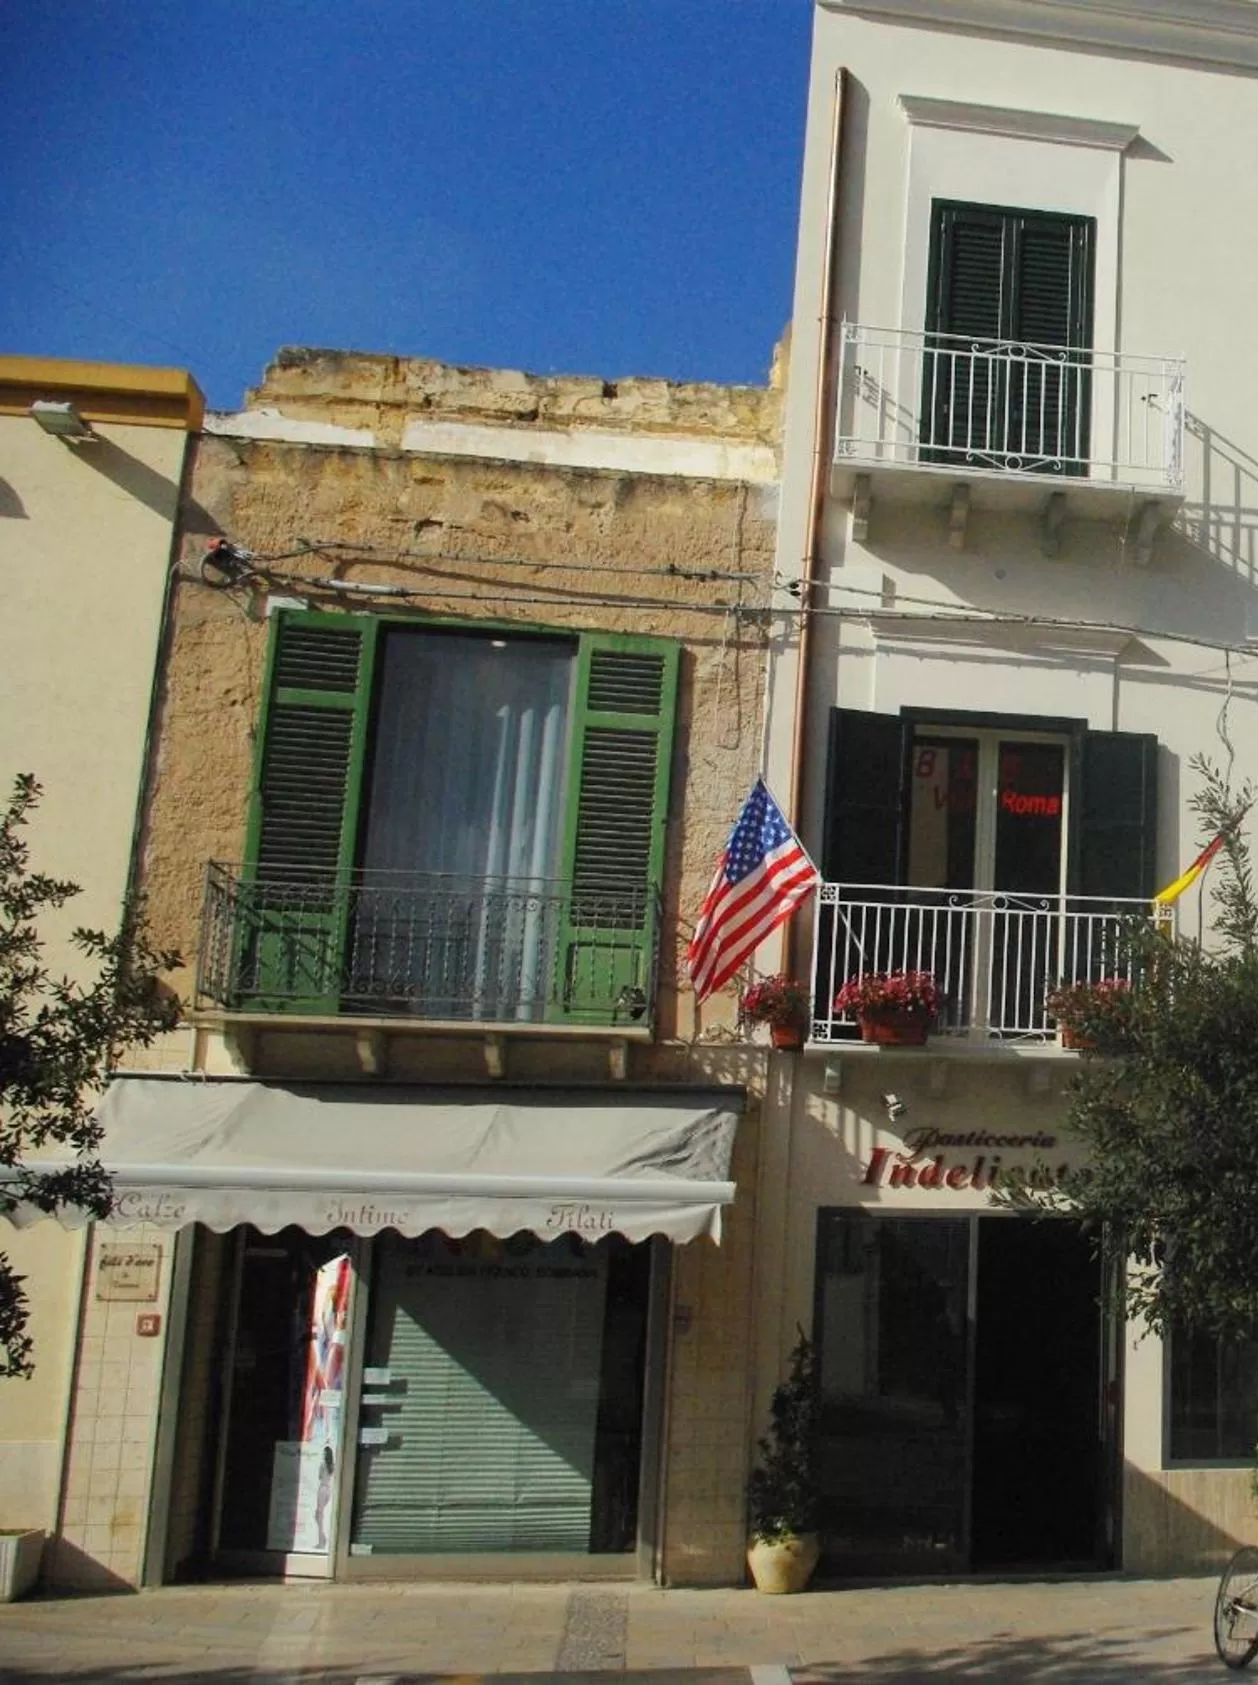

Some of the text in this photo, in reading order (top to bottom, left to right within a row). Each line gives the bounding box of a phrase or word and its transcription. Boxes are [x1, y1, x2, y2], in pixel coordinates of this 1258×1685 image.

[1002, 791, 1062, 817] Roma
[904, 1127, 1057, 1160] Pasticceria
[112, 1192, 186, 1220] Calze
[325, 1200, 410, 1225] Intimo
[546, 1203, 614, 1230] Filati
